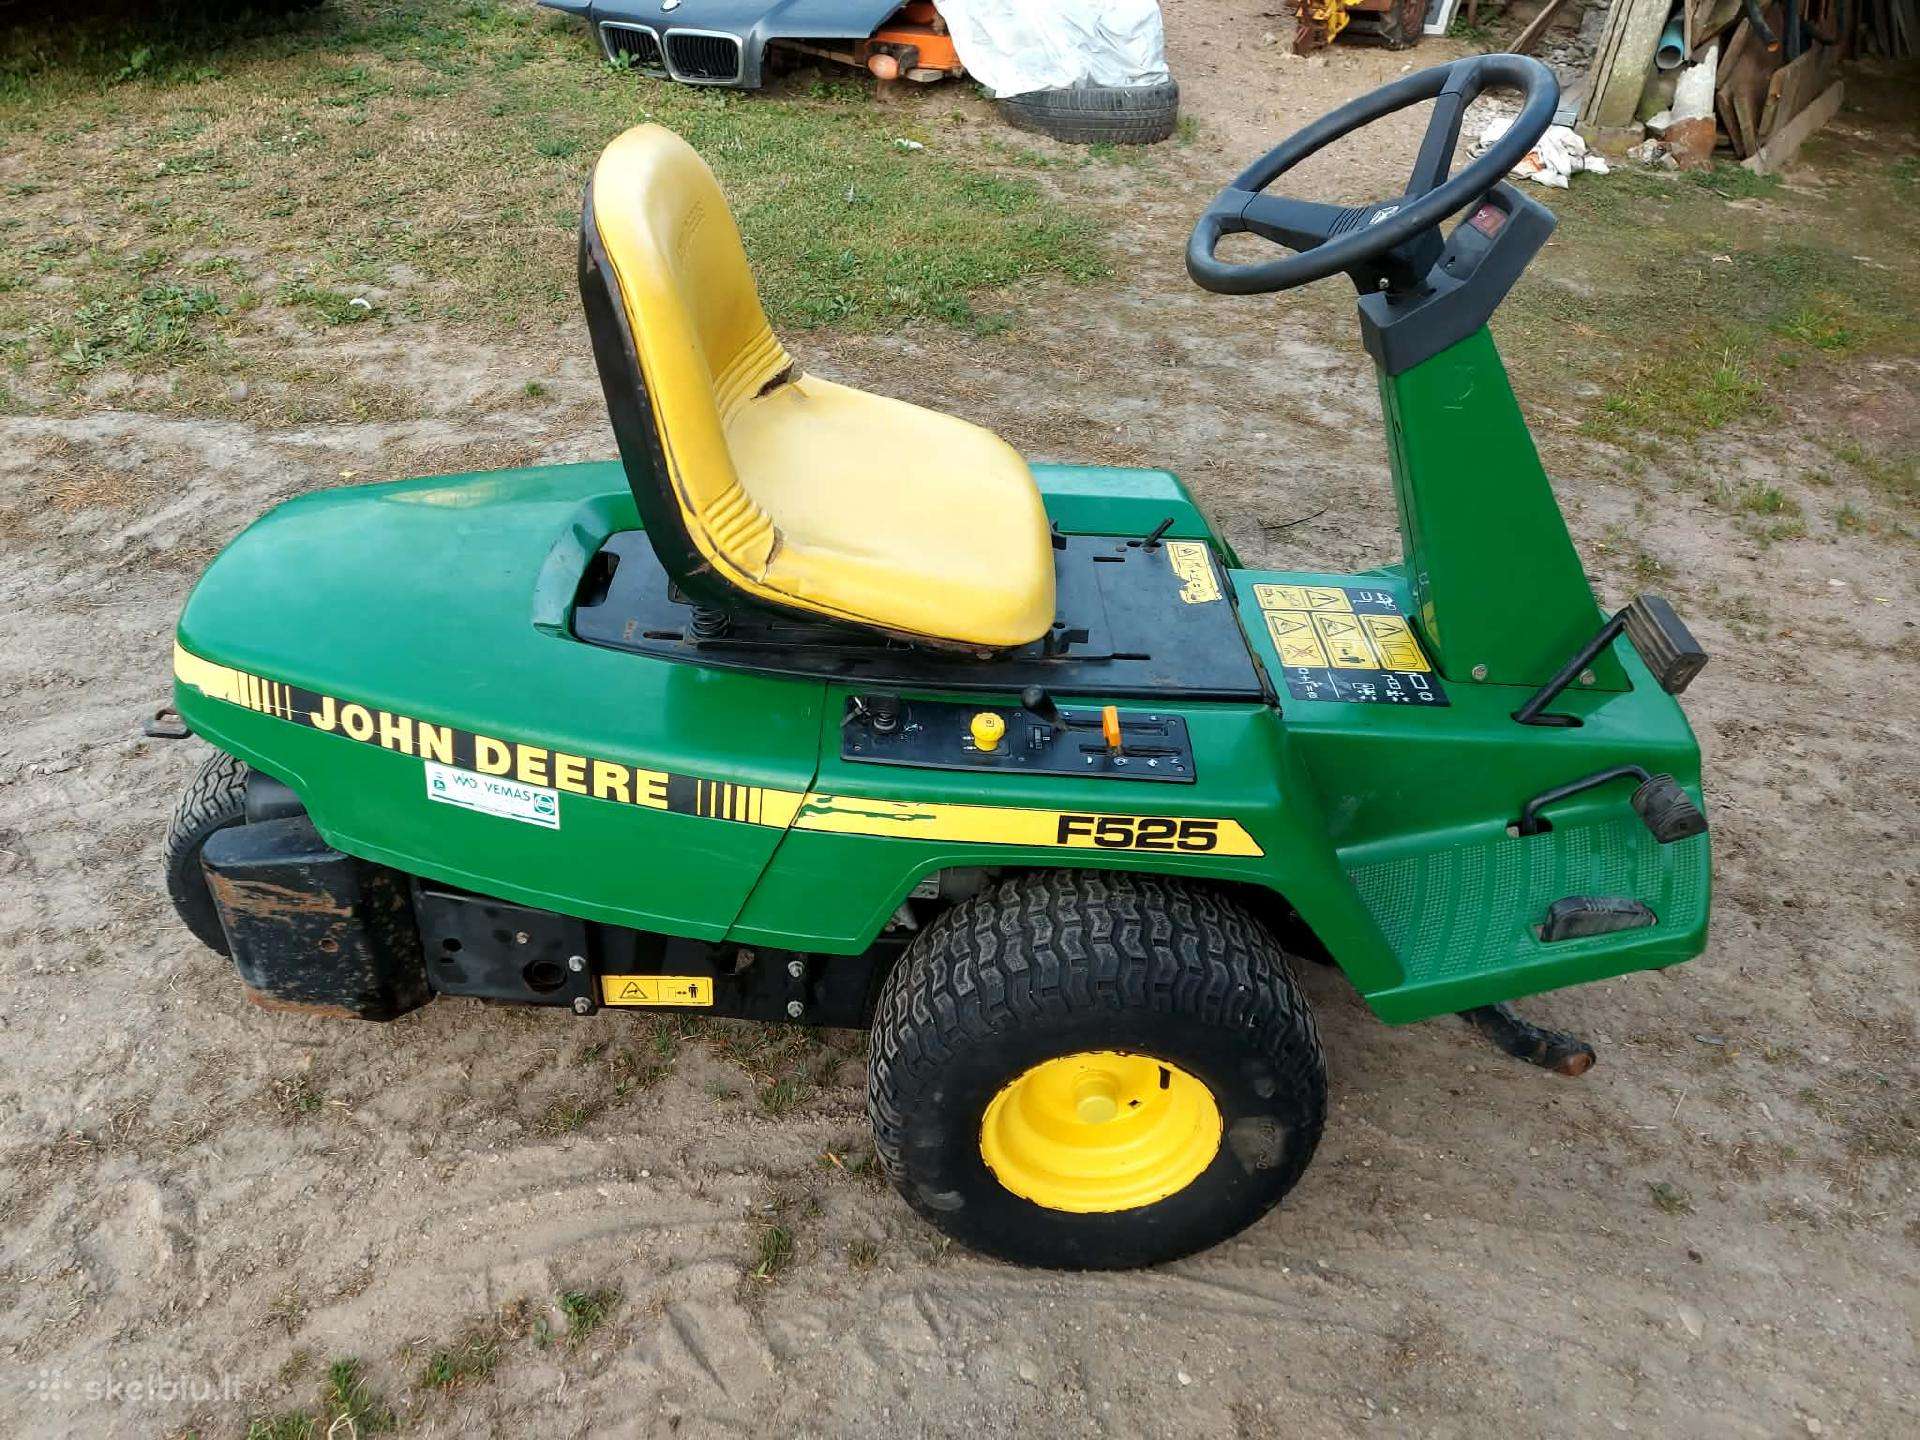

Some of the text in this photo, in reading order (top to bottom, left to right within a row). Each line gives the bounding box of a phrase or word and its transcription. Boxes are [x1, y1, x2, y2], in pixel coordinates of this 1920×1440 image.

[309, 695, 670, 809] JOHN DEERE
[484, 781, 531, 802] VEMAS
[1057, 814, 1219, 851] F525
